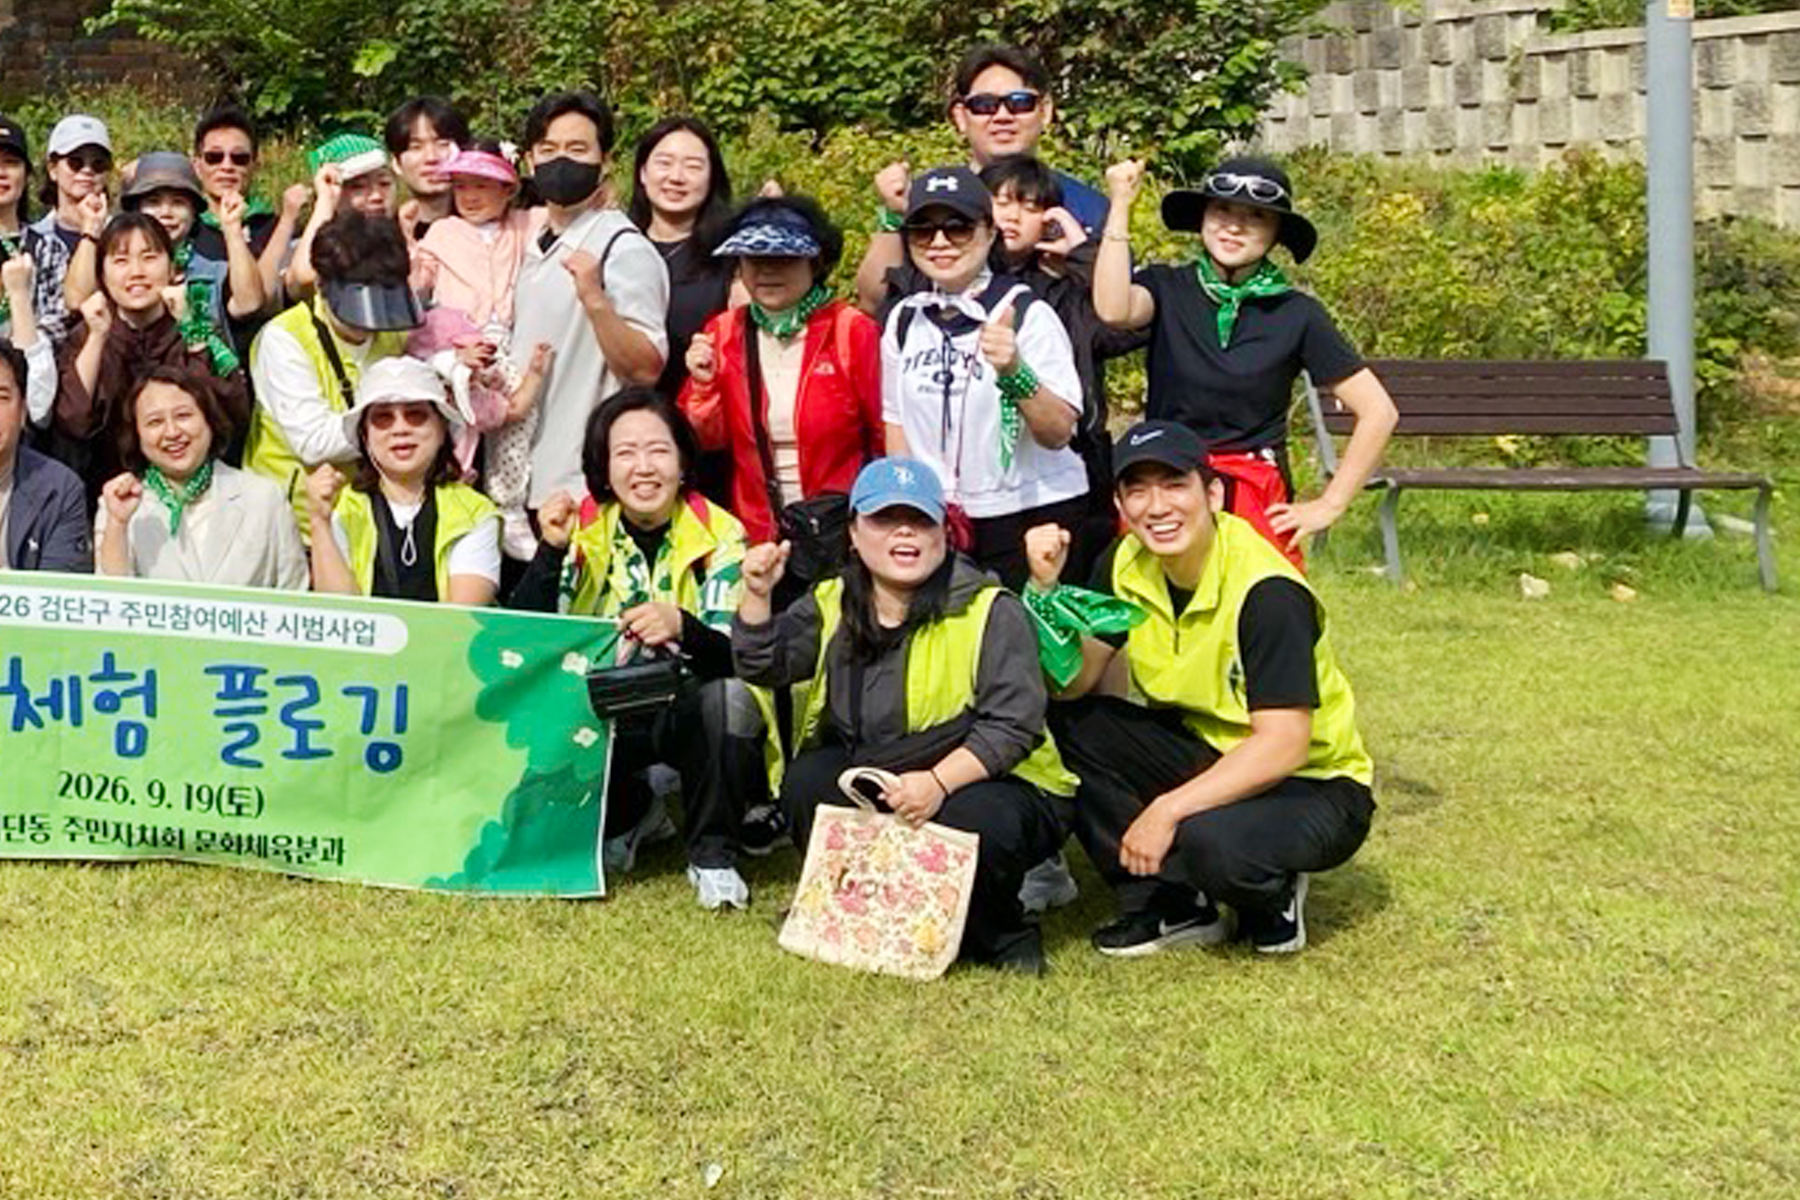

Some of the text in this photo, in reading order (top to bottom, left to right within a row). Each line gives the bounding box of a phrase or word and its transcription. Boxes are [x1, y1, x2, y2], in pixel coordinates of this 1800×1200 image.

[39, 595, 112, 626] 검단구
[119, 601, 268, 638] 주민참여예산
[276, 613, 376, 647] 시범사업
[203, 663, 410, 773] 플로깅
[58, 770, 265, 820] 2026. 9. 19(토)
[62, 815, 186, 851] 주민자치회
[195, 829, 346, 867] 문화체육분과
